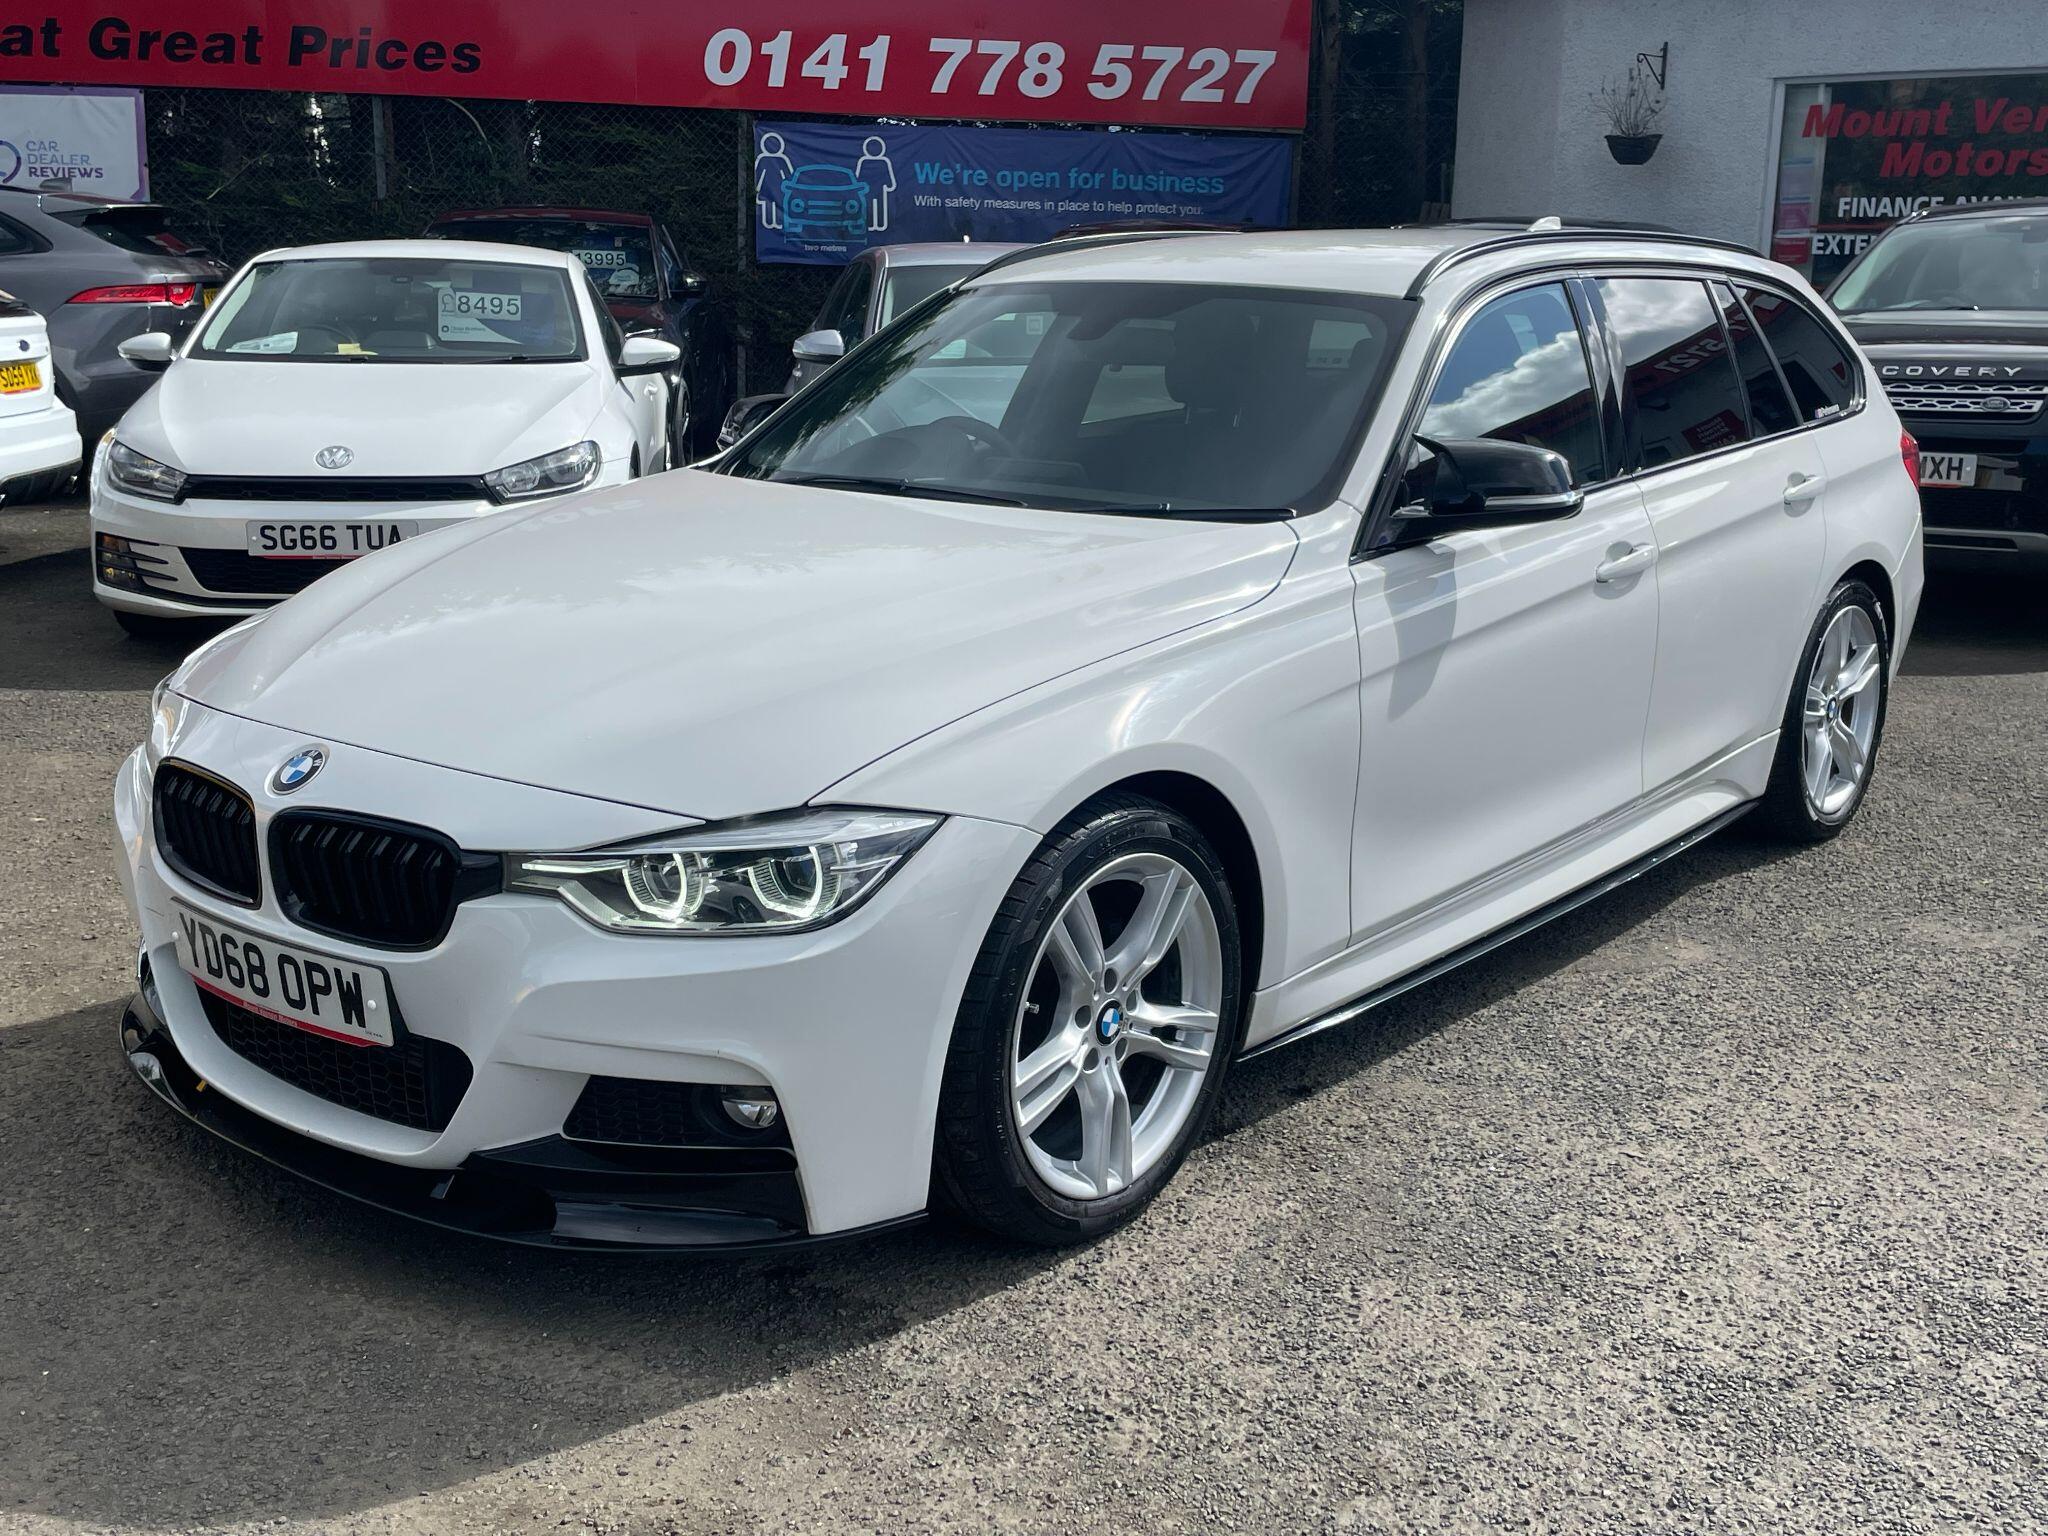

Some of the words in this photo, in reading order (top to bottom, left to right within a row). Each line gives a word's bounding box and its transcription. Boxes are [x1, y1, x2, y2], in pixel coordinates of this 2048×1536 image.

[0, 18, 60, 58] at
[88, 17, 264, 66] Great
[287, 25, 483, 74] Prices
[703, 28, 891, 92] 0141
[926, 38, 1066, 98] 778
[1086, 43, 1278, 104] 5727
[1802, 101, 1953, 138] Mount
[26, 140, 59, 152] CAR
[27, 153, 91, 166] DEALER
[1880, 142, 2048, 178] Motors
[28, 166, 104, 179] REVIEWS
[995, 168, 1061, 192] open
[1068, 167, 1105, 189] for
[1111, 168, 1225, 194] business
[913, 195, 942, 208] With
[945, 196, 981, 210] safety
[983, 199, 1042, 212] measures
[1044, 199, 1054, 212] in
[1058, 200, 1091, 213] place
[1092, 201, 1104, 213] to
[1107, 201, 1133, 215] help
[1136, 203, 1177, 216] protect
[441, 293, 520, 316] £8495
[1873, 365, 2022, 377] COVERY
[259, 525, 338, 550] SG66
[346, 525, 401, 550] TUA
[179, 911, 270, 998] YD68
[277, 953, 367, 1028] OPW
